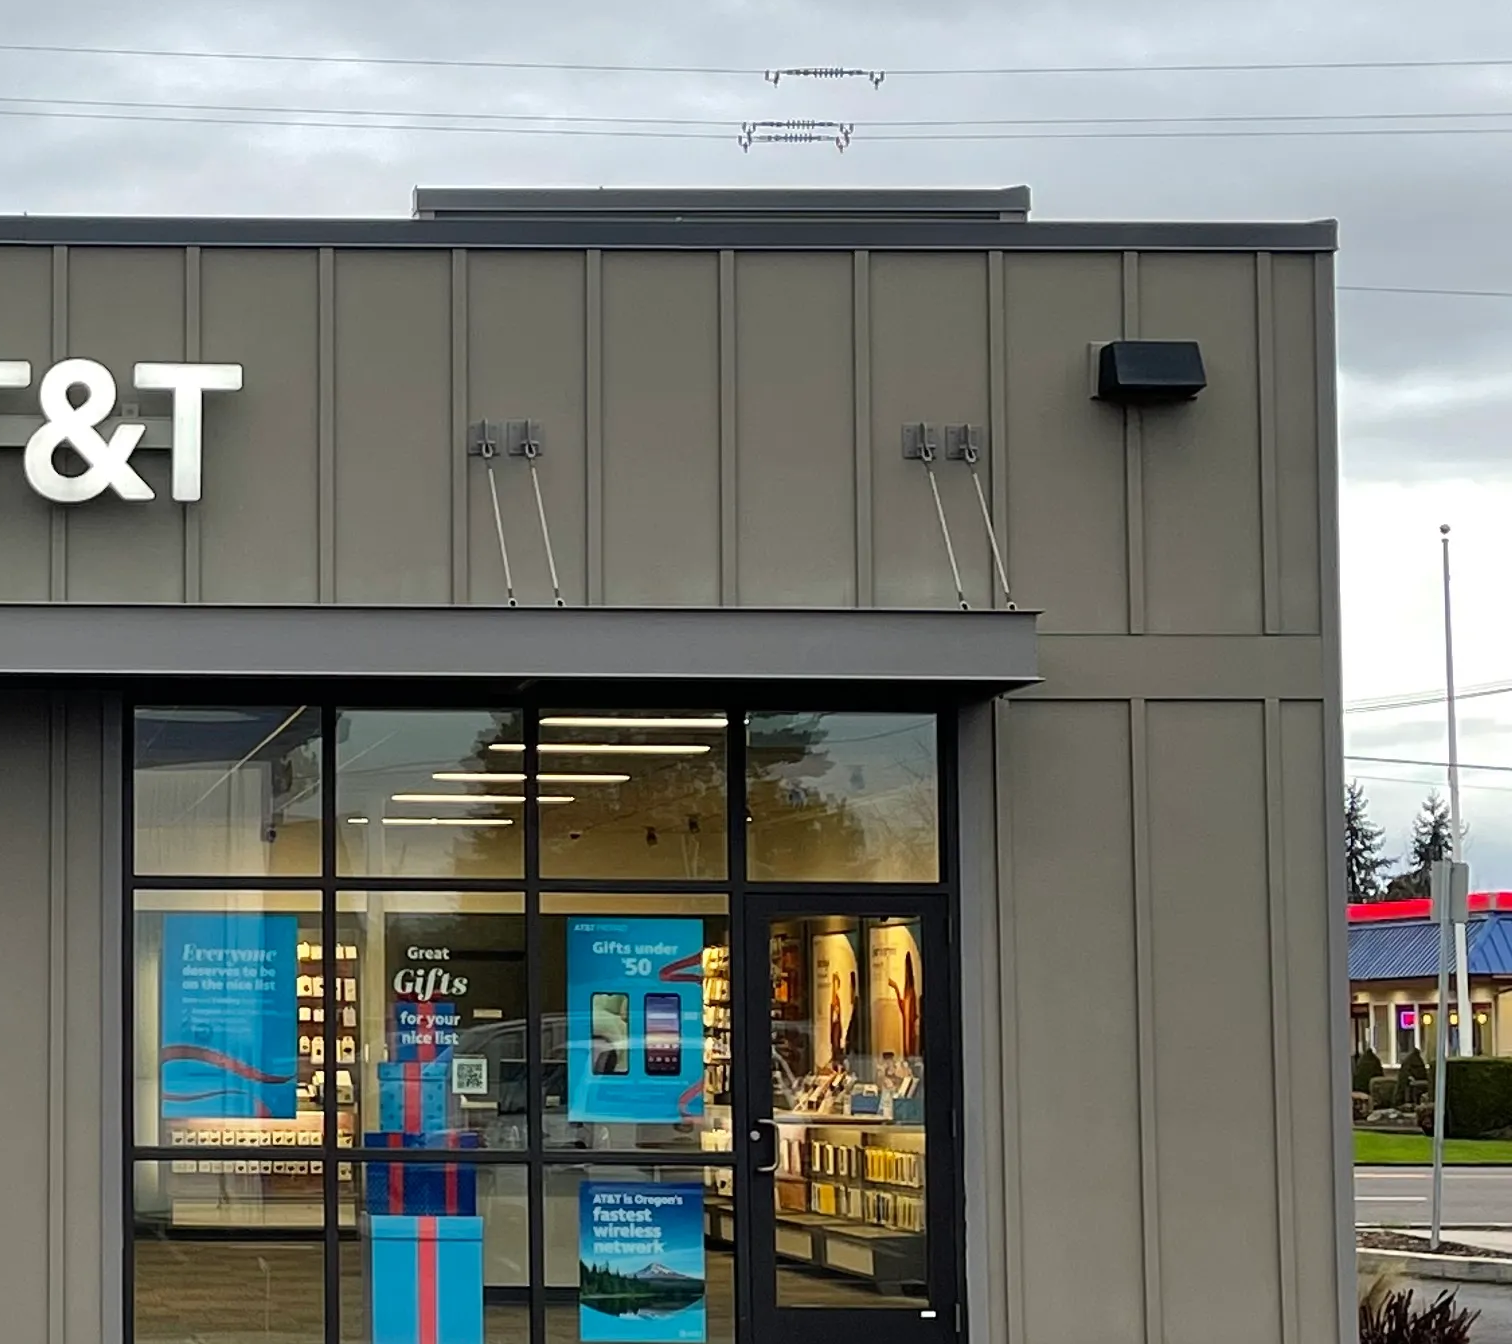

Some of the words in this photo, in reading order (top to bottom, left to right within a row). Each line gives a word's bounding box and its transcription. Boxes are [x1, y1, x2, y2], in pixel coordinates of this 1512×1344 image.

[183, 944, 277, 966] Everyone
[408, 946, 450, 960] Great
[593, 941, 631, 954] Gifts
[635, 942, 678, 955] under
[242, 966, 258, 976] to
[260, 965, 276, 976] be
[255, 978, 276, 991] list
[393, 967, 469, 1001] Gifts
[400, 1011, 423, 1025] for
[425, 1014, 461, 1029] your
[402, 1031, 432, 1044] nice
[434, 1031, 460, 1045] list
[592, 1194, 622, 1205] AT&T
[634, 1194, 684, 1207] Oregon's
[593, 1206, 652, 1222] fastest
[593, 1223, 662, 1239] wireless
[593, 1239, 665, 1255] network
